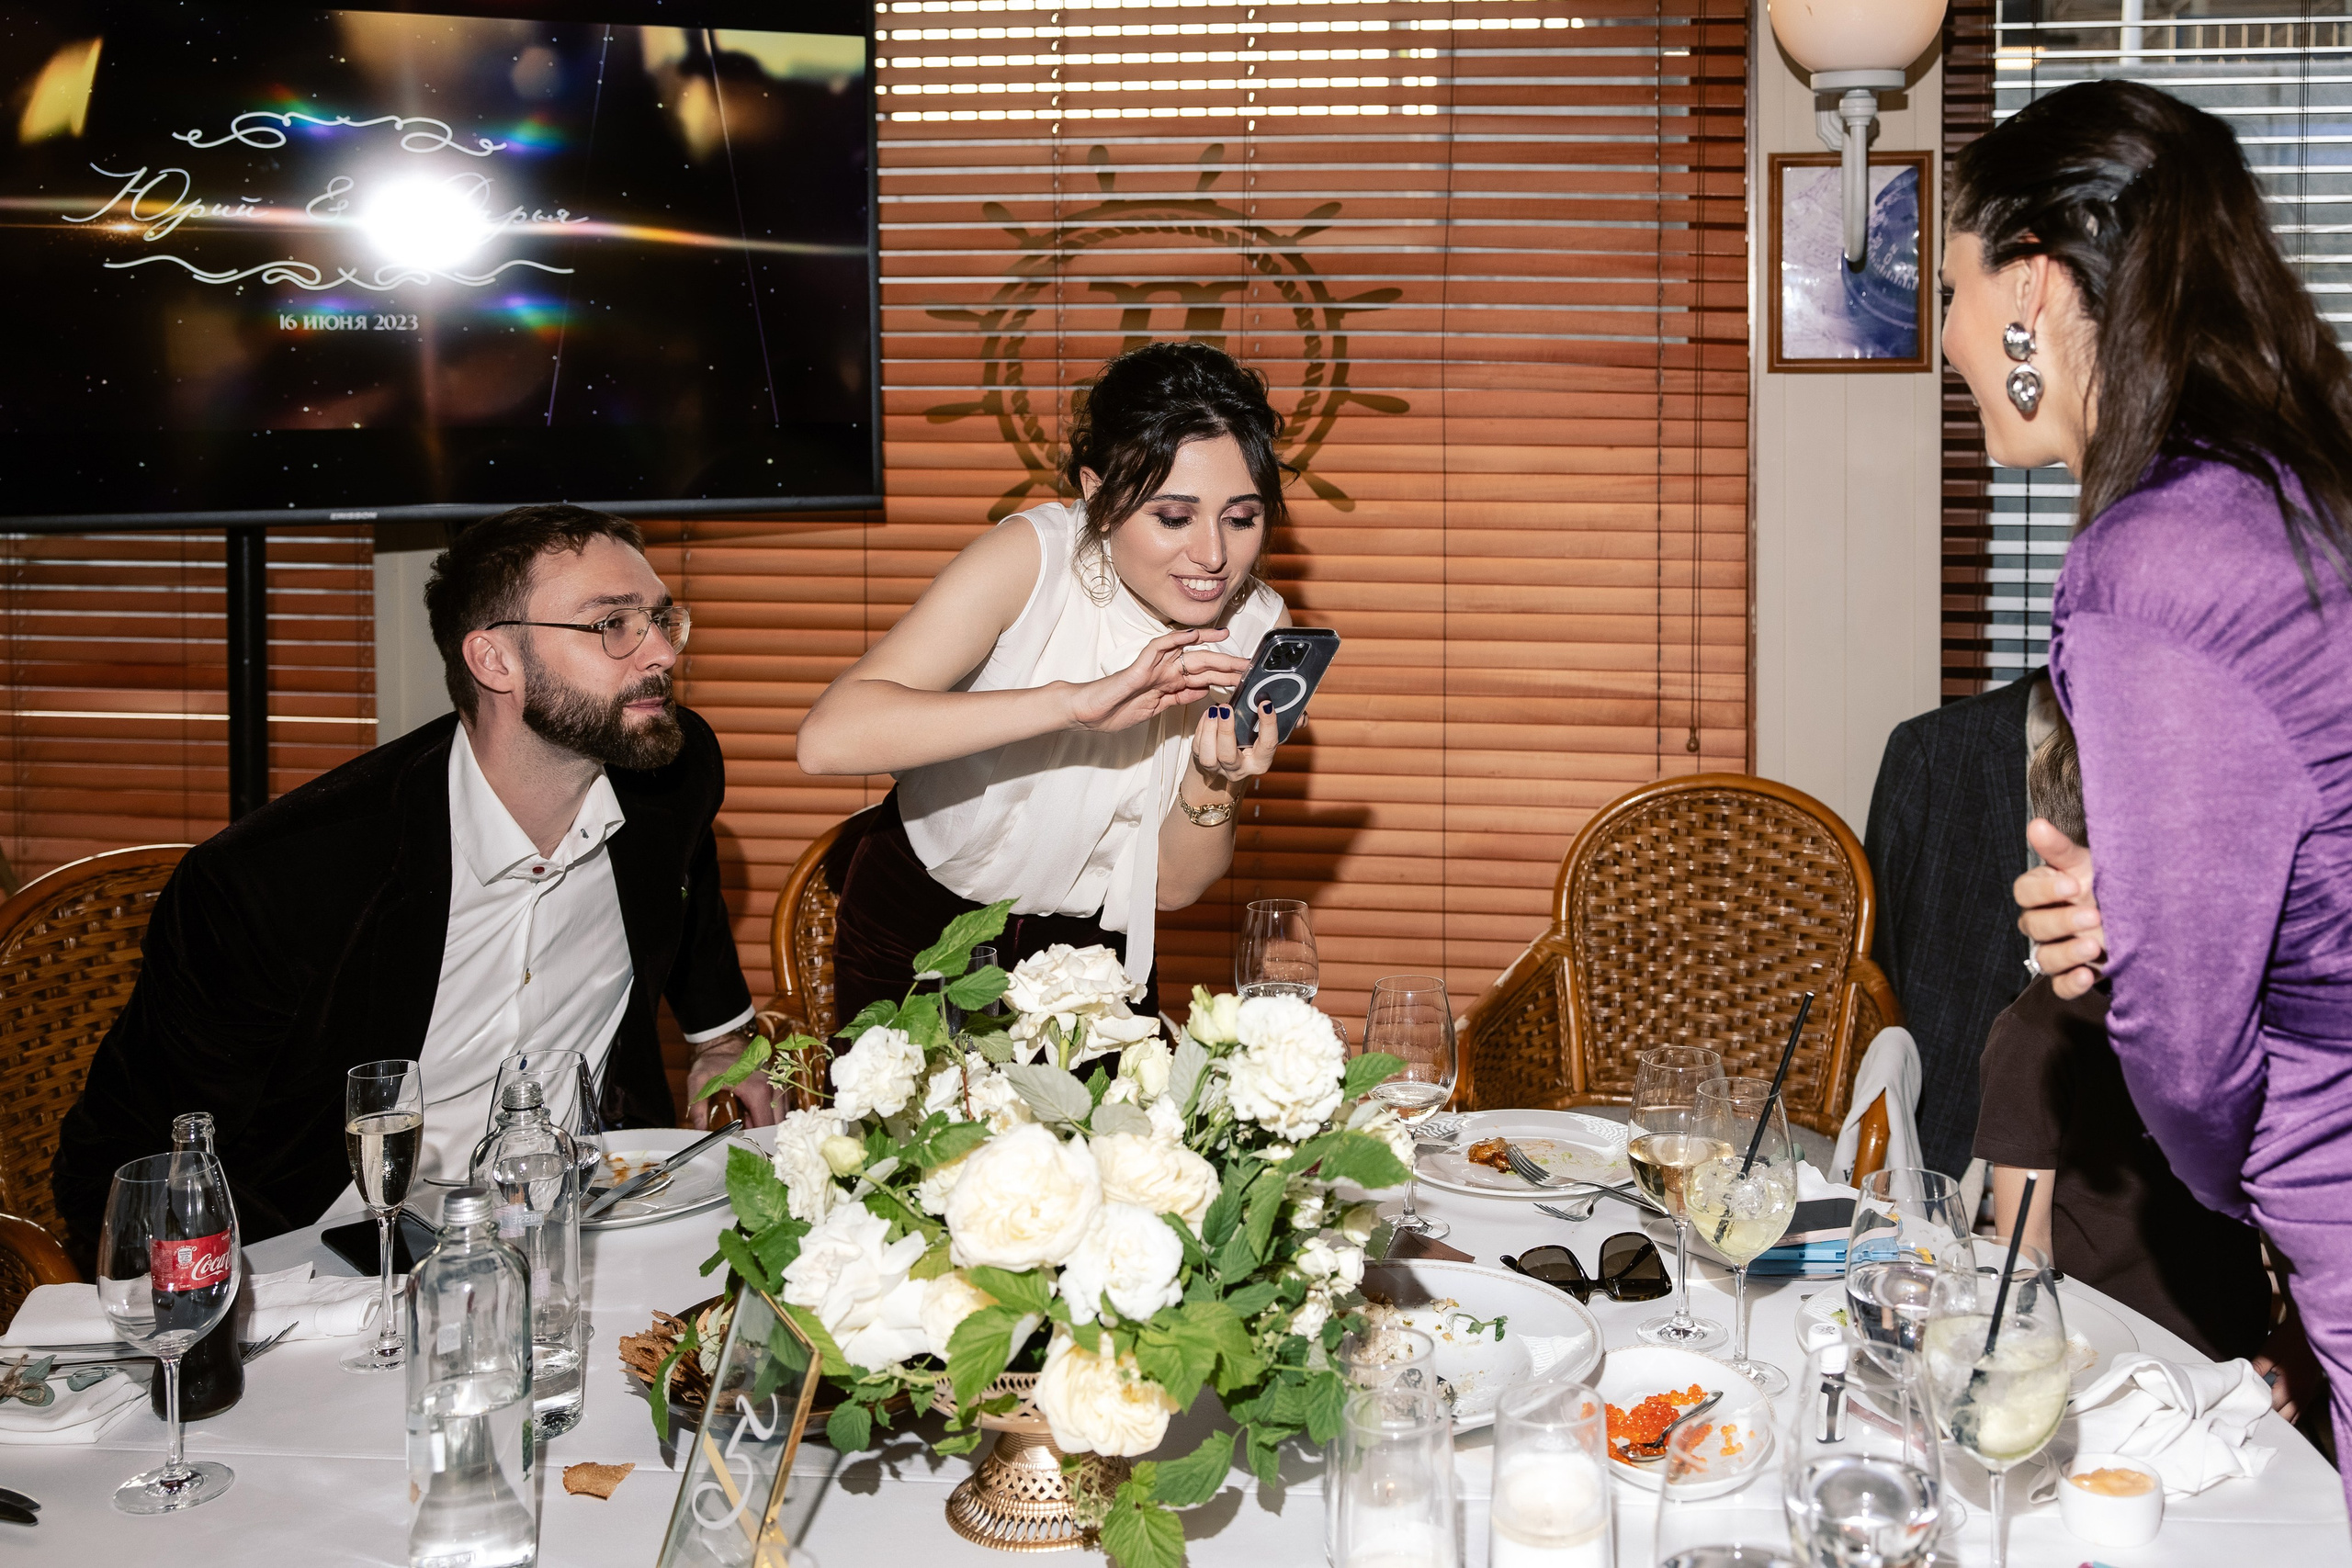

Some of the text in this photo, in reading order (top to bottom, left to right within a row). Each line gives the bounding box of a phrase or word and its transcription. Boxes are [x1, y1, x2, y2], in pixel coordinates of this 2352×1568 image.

[62, 162, 269, 242] Юрий
[279, 313, 419, 331] 16 ИЮНЯ 2023
